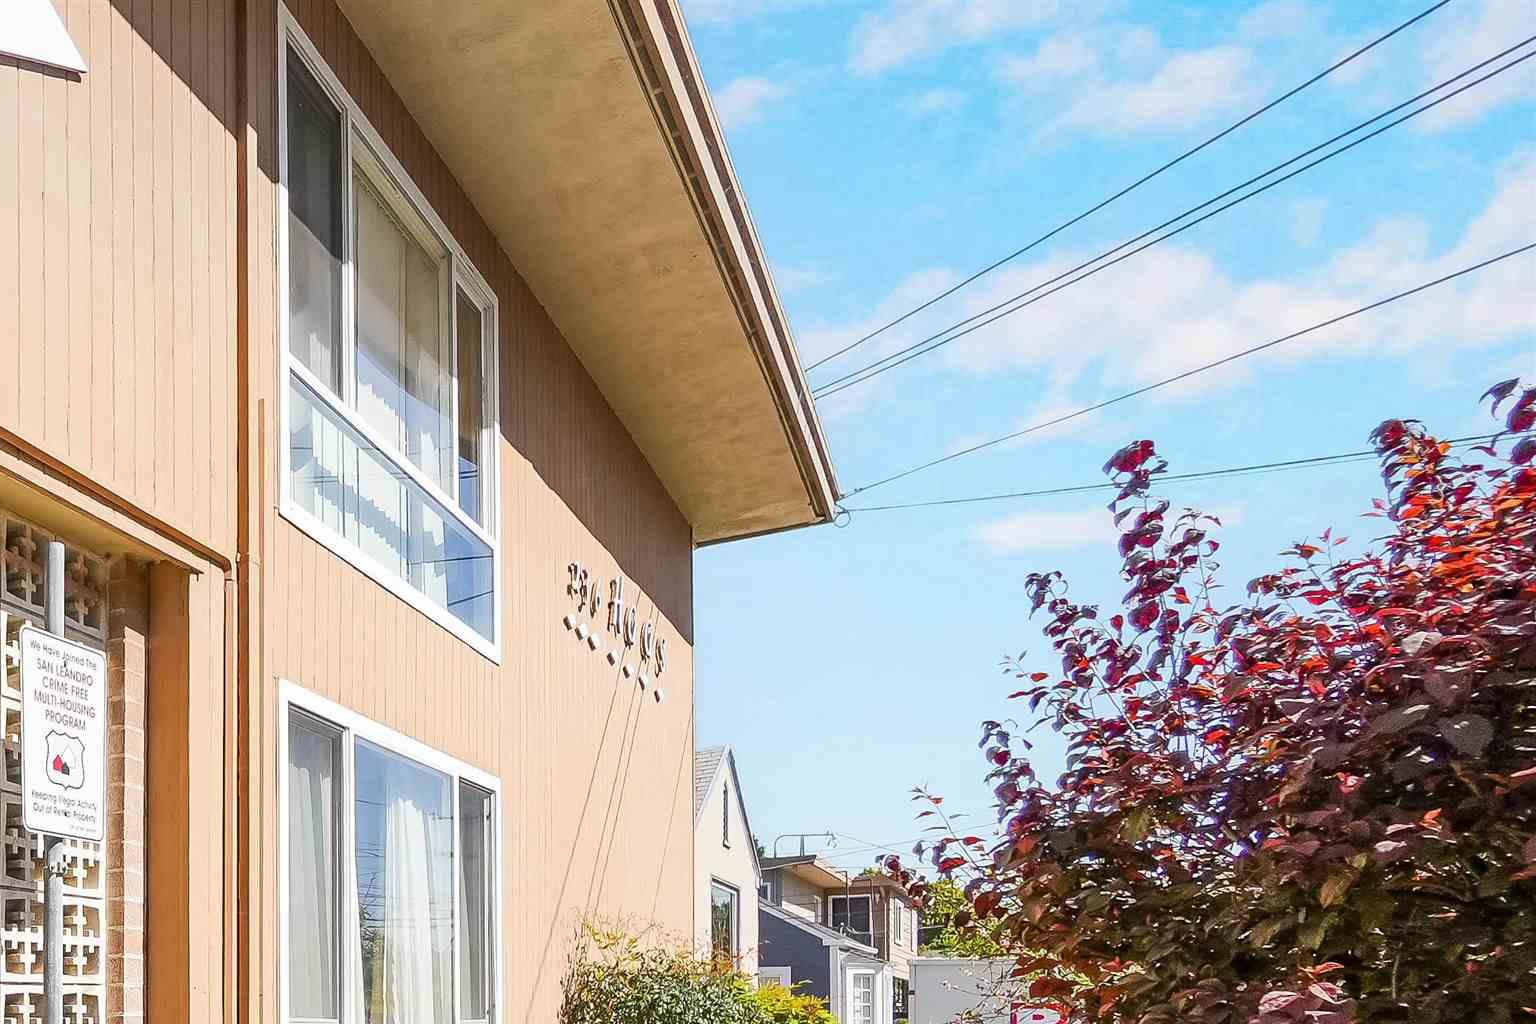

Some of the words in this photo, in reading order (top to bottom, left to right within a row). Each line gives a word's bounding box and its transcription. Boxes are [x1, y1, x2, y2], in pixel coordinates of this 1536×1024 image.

[30, 640, 41, 651] We
[43, 644, 60, 658] Have
[62, 651, 84, 667] Joined
[86, 658, 96, 670] The
[37, 658, 53, 673] SAN
[56, 664, 94, 687] LEANDRO
[34, 688, 96, 718] MULTI-HOUSING
[42, 676, 68, 695] CRIME
[71, 685, 88, 701] FREE
[45, 709, 86, 731] PROGRAM
